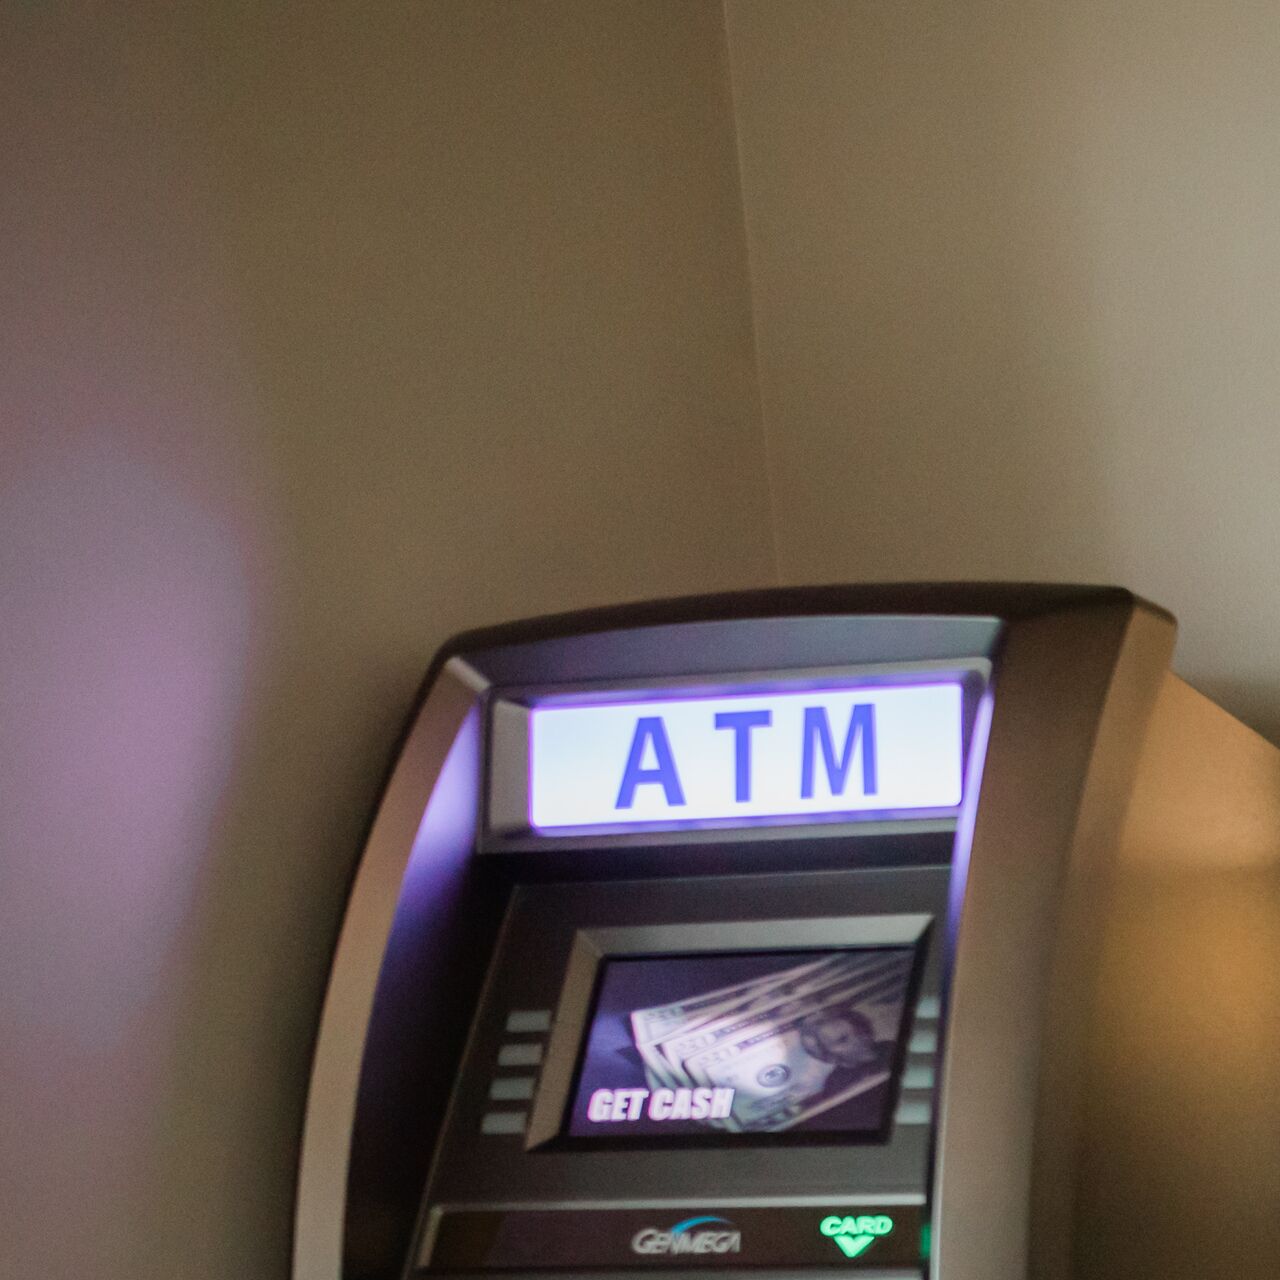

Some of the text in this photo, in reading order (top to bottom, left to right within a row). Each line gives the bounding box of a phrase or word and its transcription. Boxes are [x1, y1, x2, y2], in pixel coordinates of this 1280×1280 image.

[614, 703, 878, 810] ATM
[587, 1087, 736, 1123] GET CASH
[819, 1215, 894, 1236] CARD
